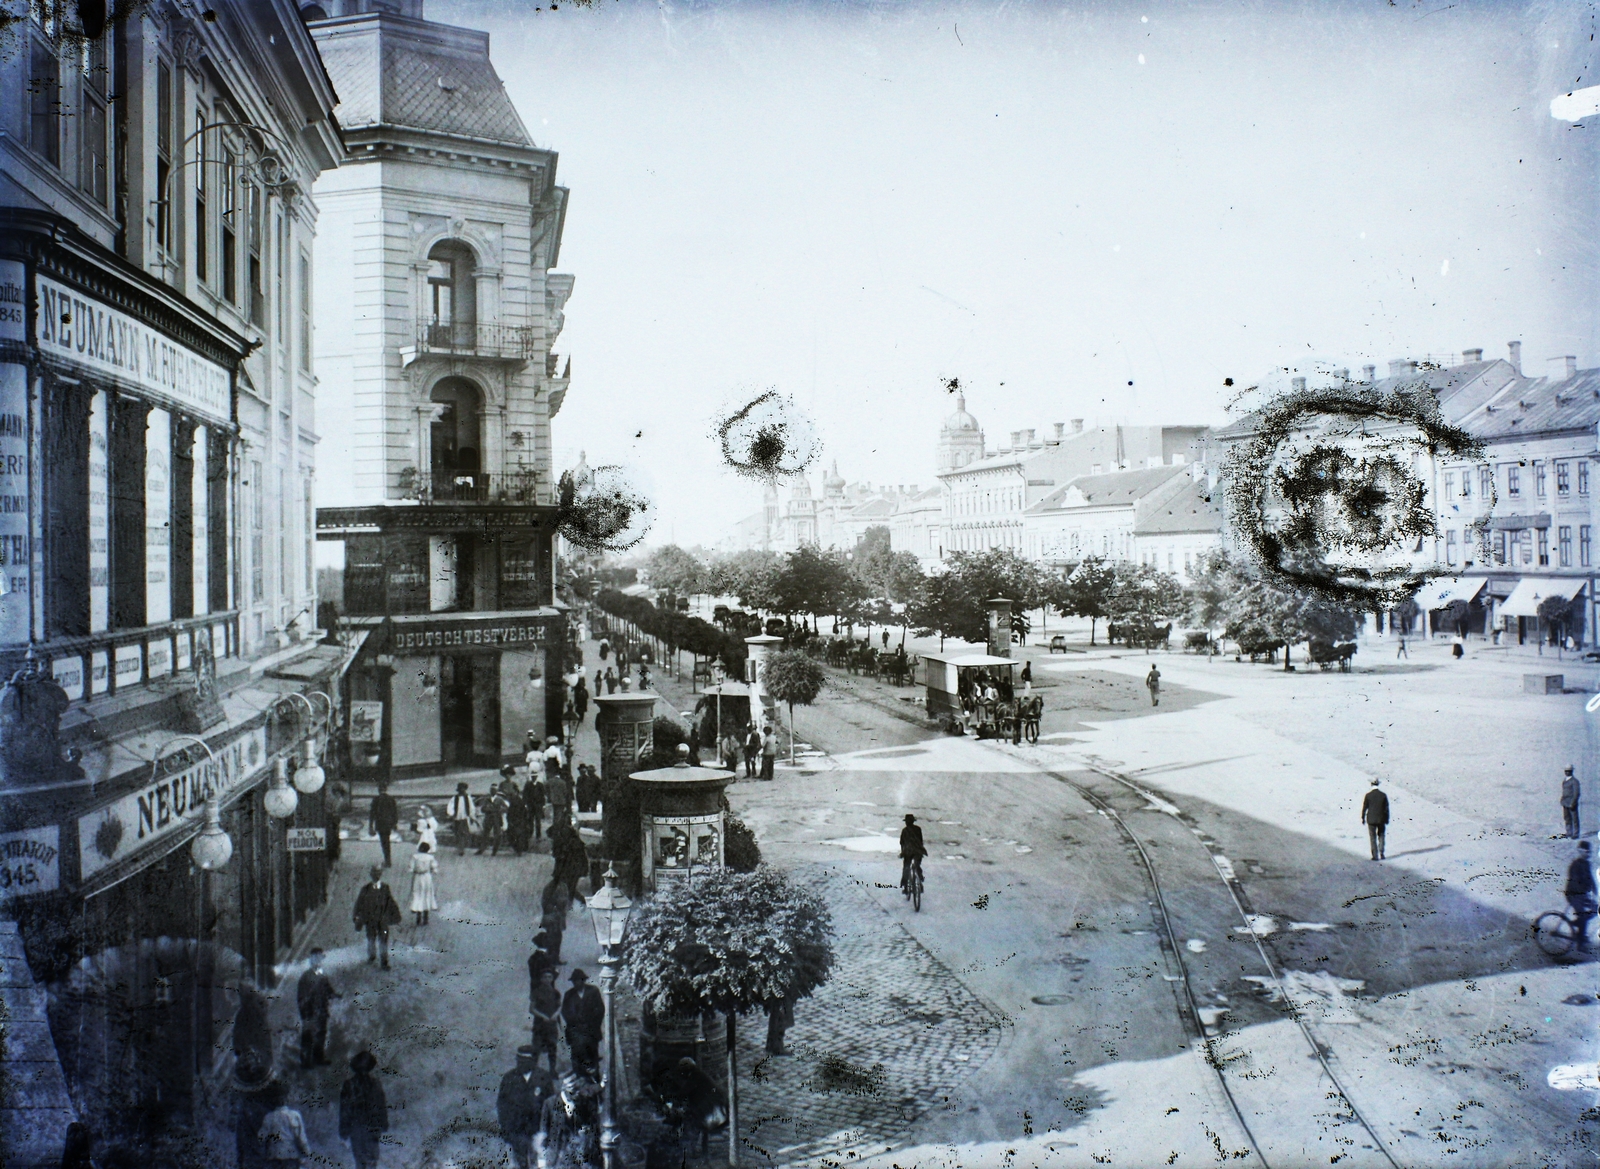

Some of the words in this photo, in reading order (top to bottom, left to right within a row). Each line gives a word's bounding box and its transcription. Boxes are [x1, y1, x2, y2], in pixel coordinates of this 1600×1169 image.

[42, 283, 140, 377] NEUMANN
[396, 630, 462, 648] DEUTSCH
[464, 625, 545, 643] TESTVÉREK
